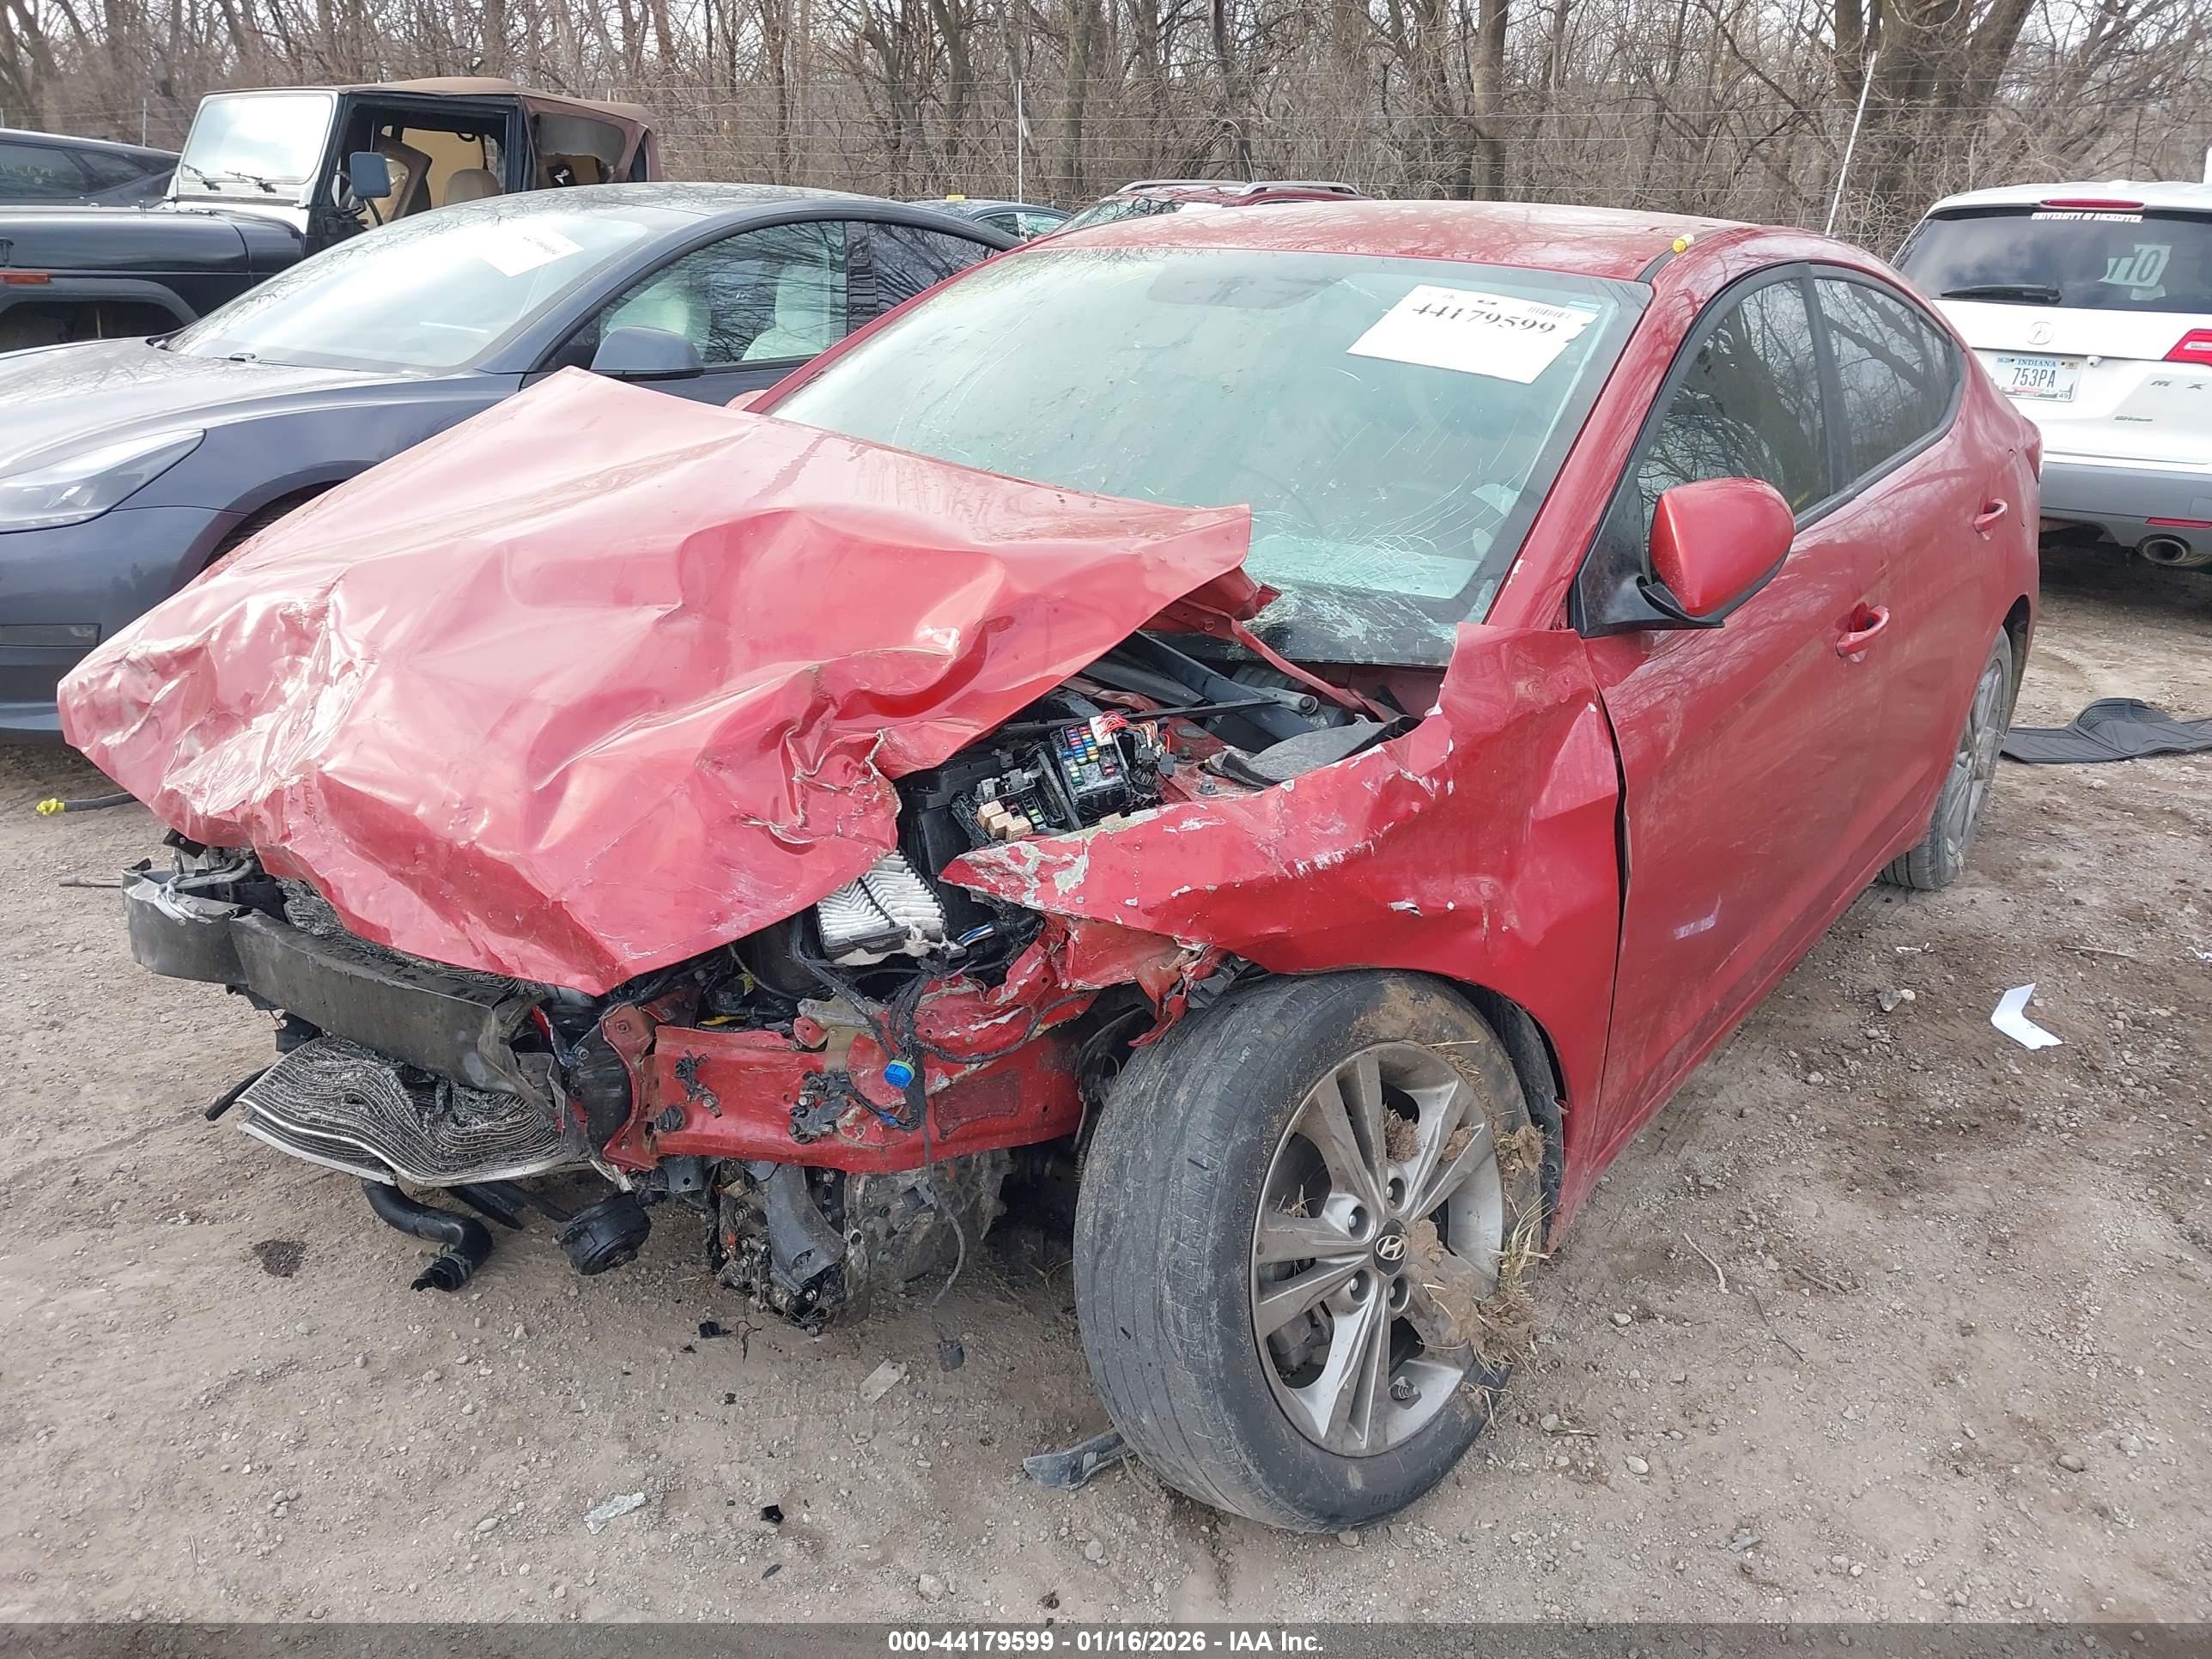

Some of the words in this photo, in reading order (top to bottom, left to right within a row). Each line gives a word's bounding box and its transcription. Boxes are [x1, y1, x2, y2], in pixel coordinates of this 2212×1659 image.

[1412, 302, 1557, 334] 44179599
[2018, 358, 2057, 368] INDIANA
[2012, 367, 2057, 388] 753PA
